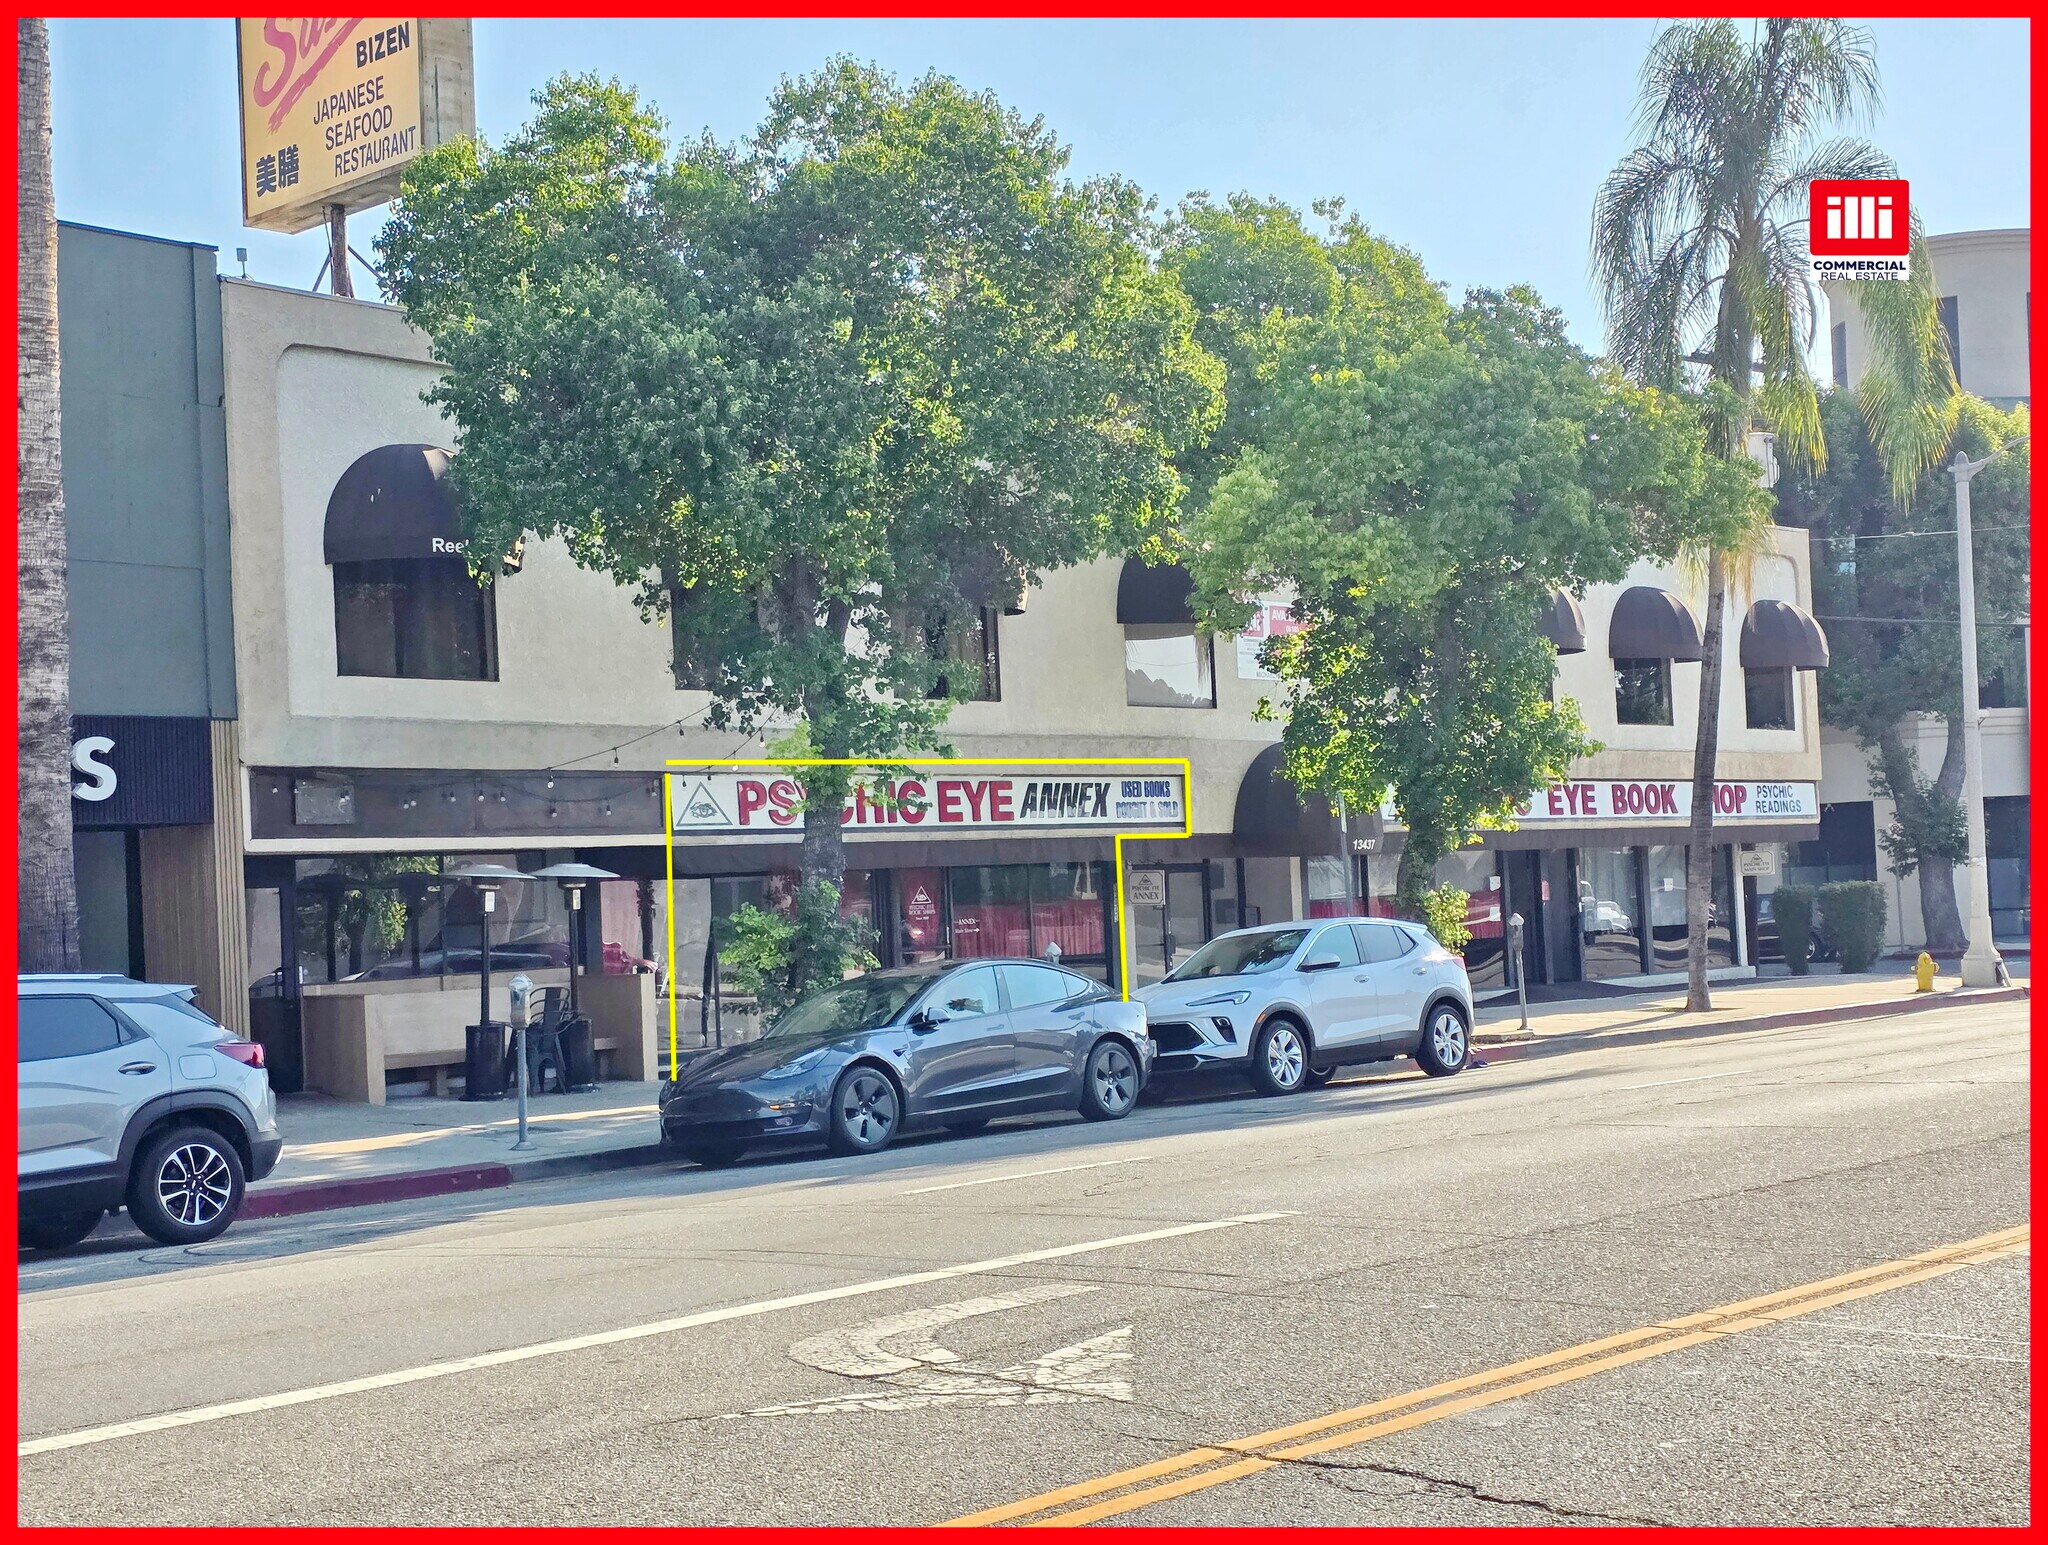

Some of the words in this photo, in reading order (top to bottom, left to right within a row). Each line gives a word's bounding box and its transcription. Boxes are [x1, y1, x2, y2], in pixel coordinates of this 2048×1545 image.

[355, 20, 411, 69] BIZEN
[313, 75, 385, 126] JAPANESE
[325, 104, 394, 151] SEAFOOD
[256, 144, 300, 198] 美膳
[334, 125, 417, 178] RESTAURANT
[71, 735, 118, 802] S
[1121, 780, 1142, 798] USED
[1144, 780, 1171, 798] BOOKS
[1756, 784, 1794, 800] PSYCHIC
[736, 780, 927, 826] PSHIC
[937, 779, 1015, 822] EYE
[1019, 782, 1111, 819] ANNEX
[1547, 784, 1598, 816] EYE
[1611, 783, 1678, 815] BOOK
[1755, 799, 1802, 814] READINGS
[1352, 839, 1376, 850] 13437
